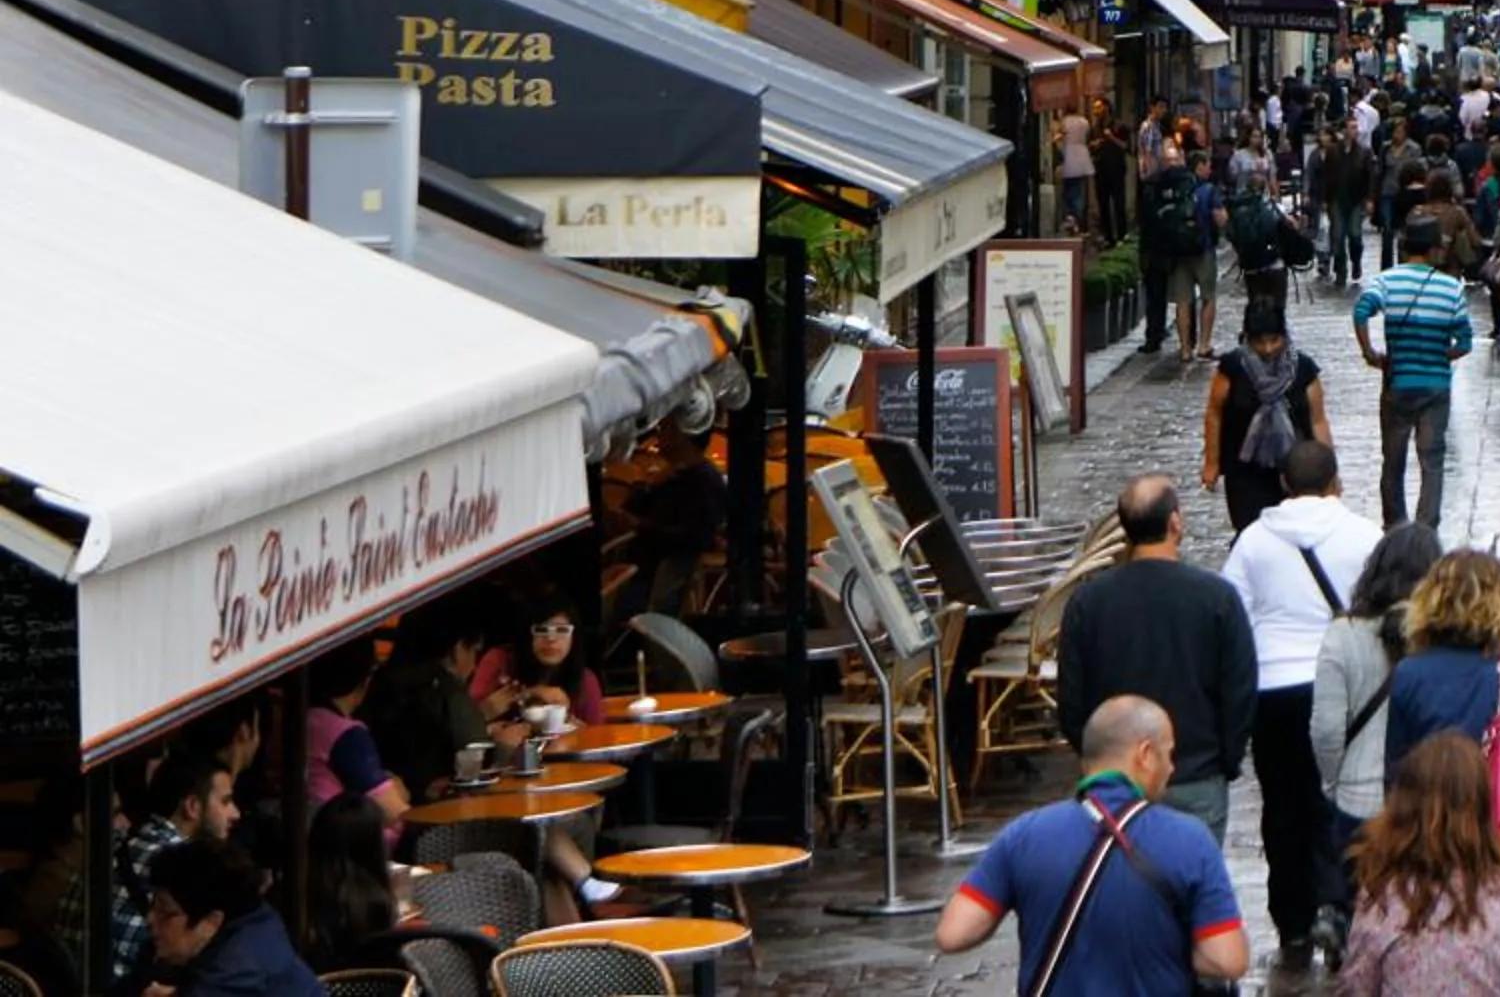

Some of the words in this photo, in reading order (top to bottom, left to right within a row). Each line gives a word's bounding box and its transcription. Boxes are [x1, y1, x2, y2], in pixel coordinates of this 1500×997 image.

[396, 15, 554, 63] Pizza
[556, 196, 607, 227] La
[623, 194, 727, 228] Perla
[210, 544, 249, 663] La
